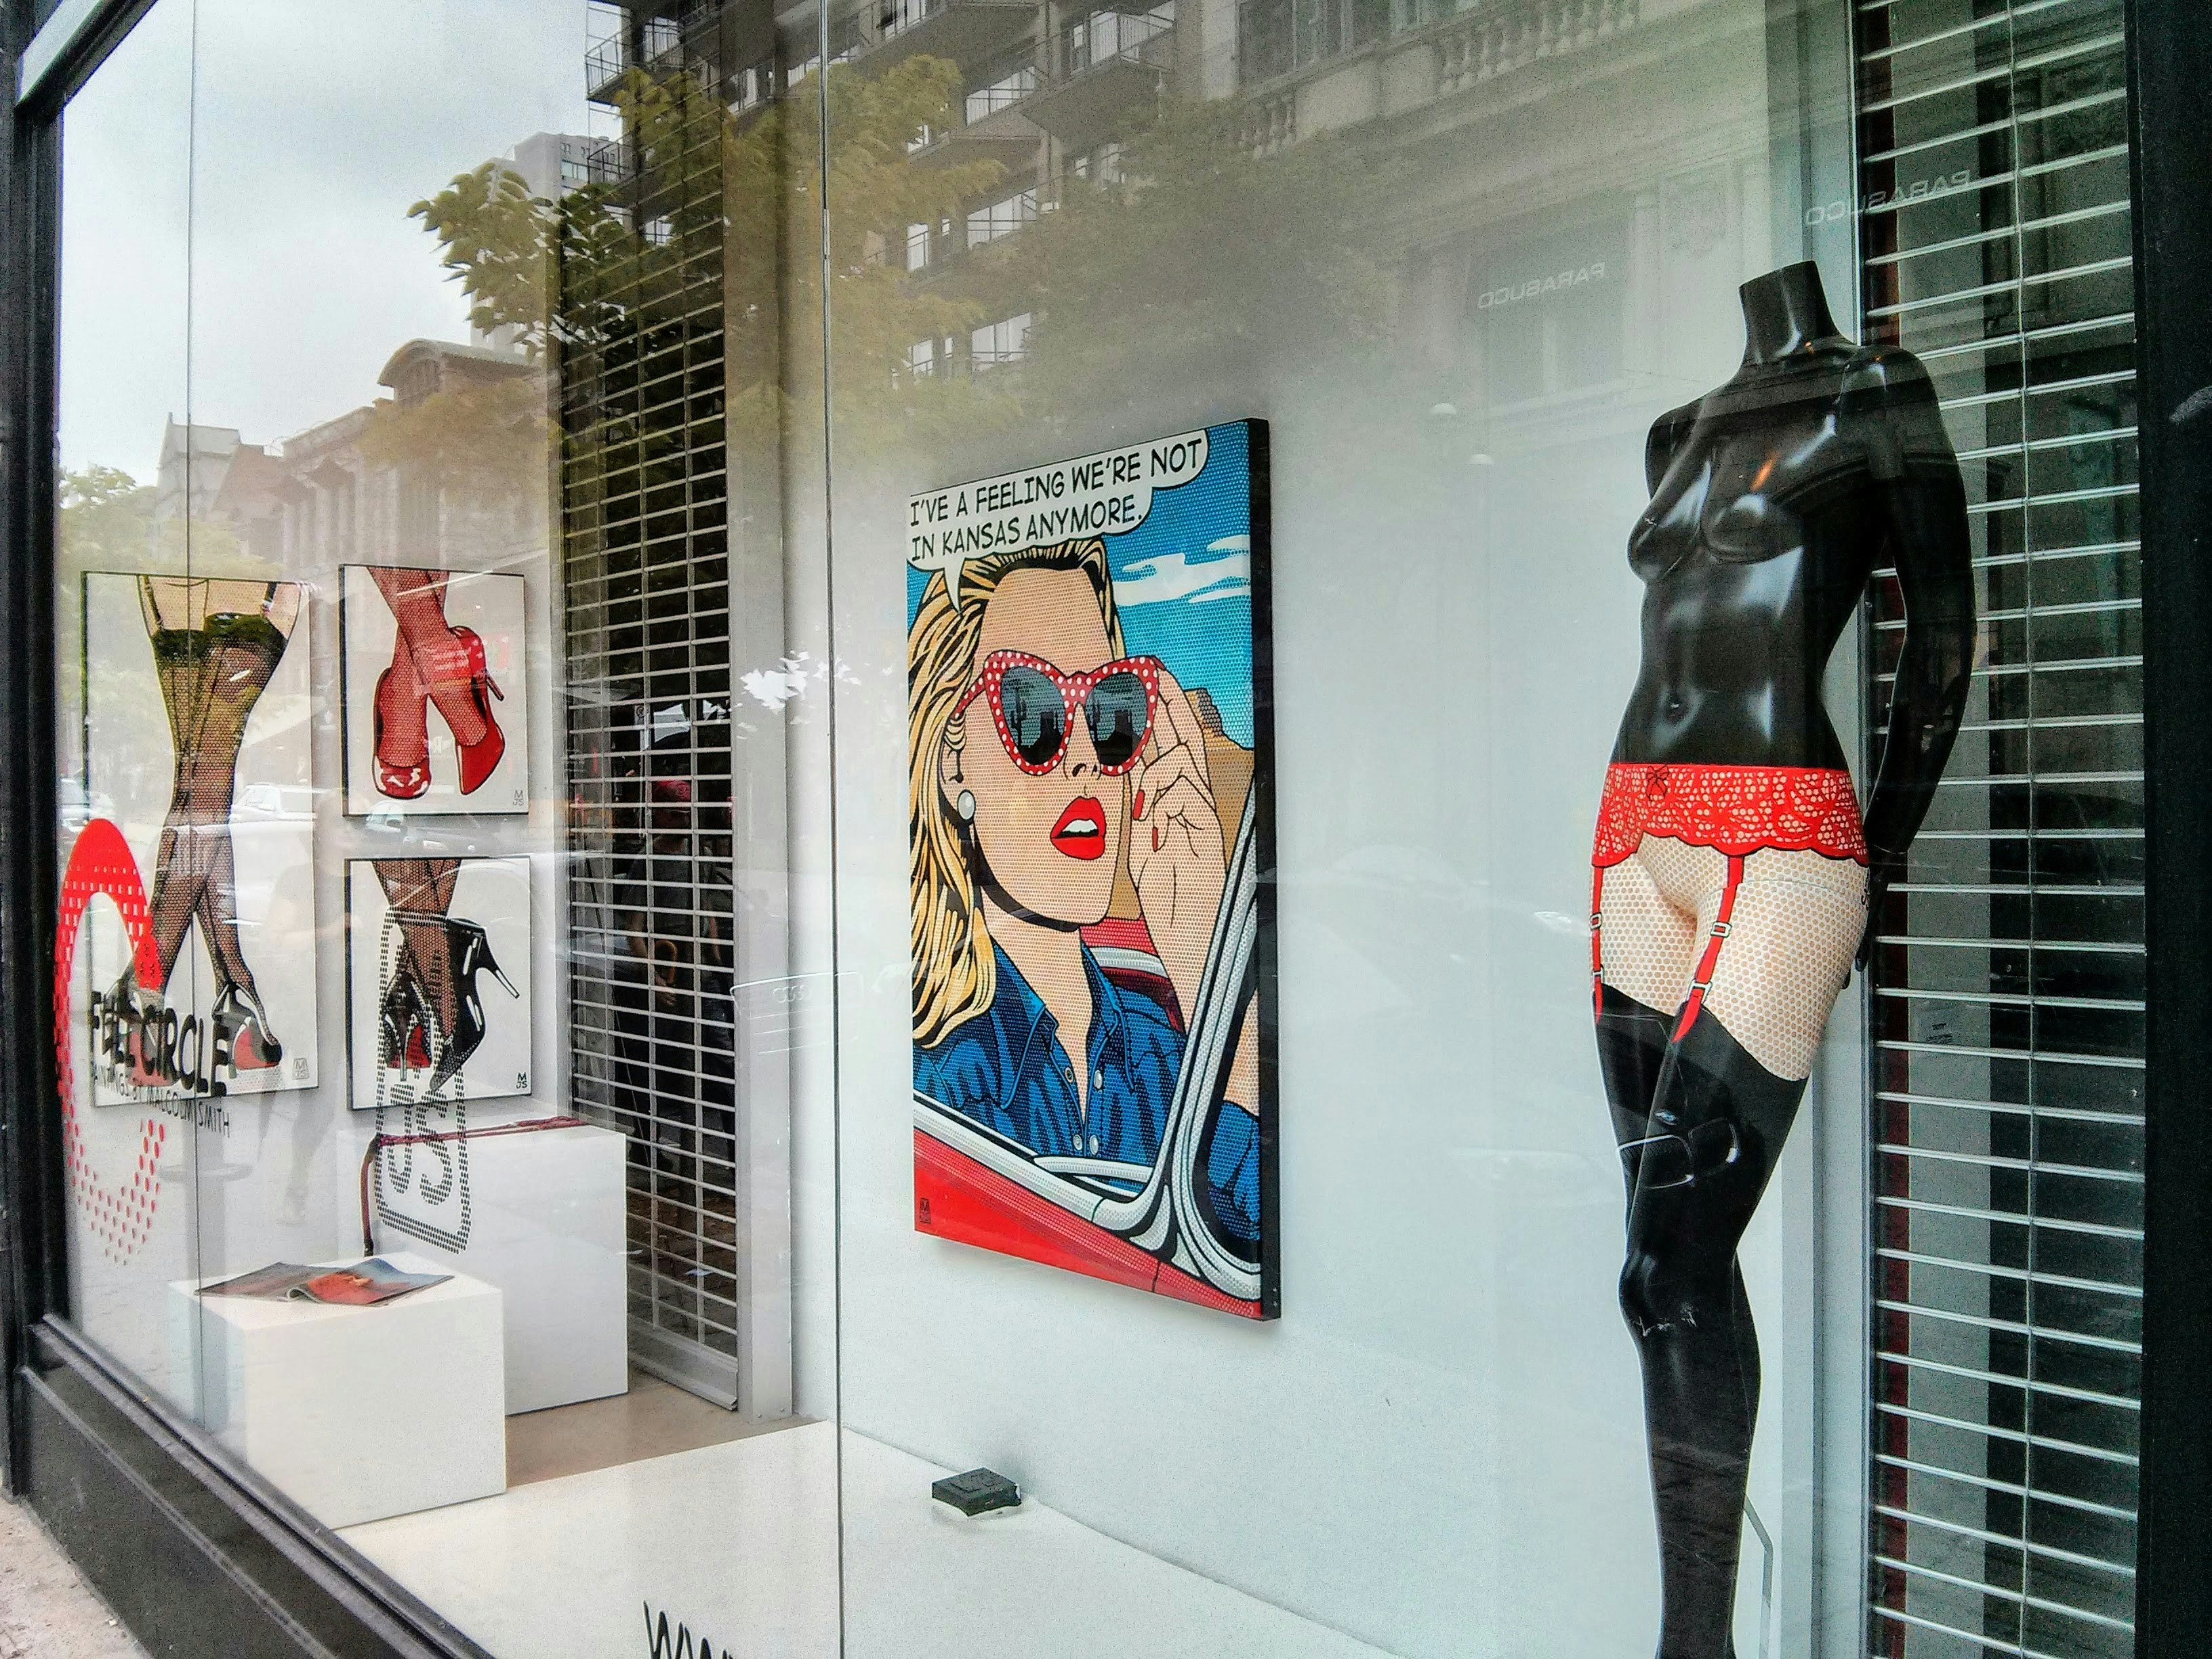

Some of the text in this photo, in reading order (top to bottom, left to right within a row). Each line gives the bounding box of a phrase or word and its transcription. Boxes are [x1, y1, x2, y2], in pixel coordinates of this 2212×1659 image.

[910, 438, 1202, 527] I'VE A FEELING WE'RE NOT
[912, 494, 1143, 561] IN KANSAS ANYMORE.
[514, 789, 523, 798] M
[140, 1004, 229, 1097] CIRCLE
[517, 1072, 527, 1081] M
[146, 1084, 193, 1124] MALCOLM
[198, 1101, 230, 1138] SMITH
[516, 1080, 528, 1089] JS
